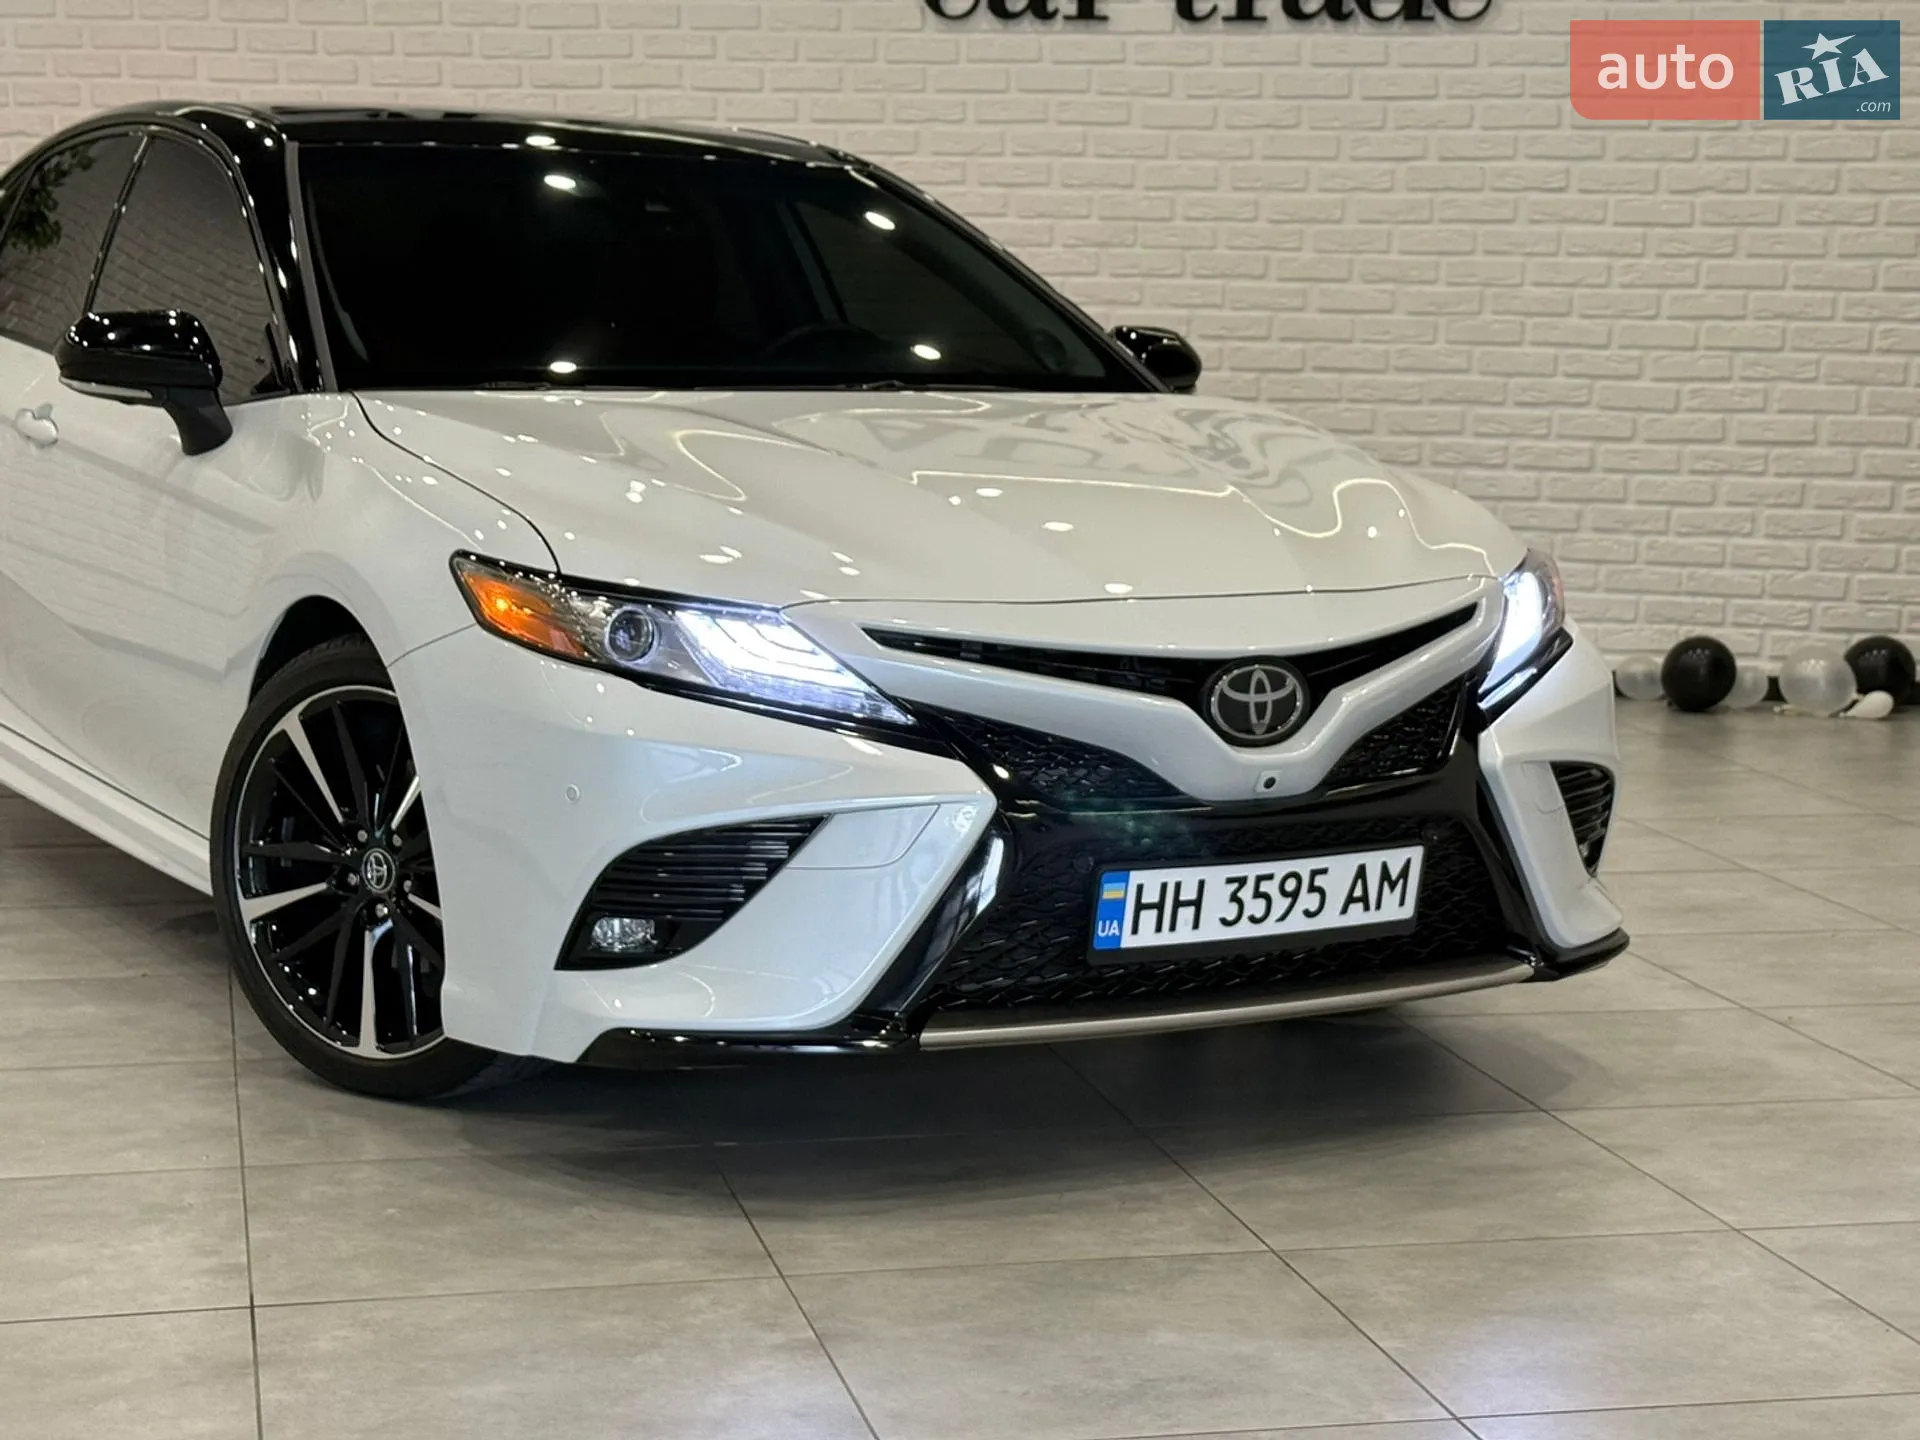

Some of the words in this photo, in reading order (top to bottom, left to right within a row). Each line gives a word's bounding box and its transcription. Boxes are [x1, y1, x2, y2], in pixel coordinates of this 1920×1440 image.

[1130, 878, 1206, 936] HH
[1218, 866, 1330, 927] 3595
[1339, 856, 1412, 916] AM
[1097, 919, 1120, 938] UA
